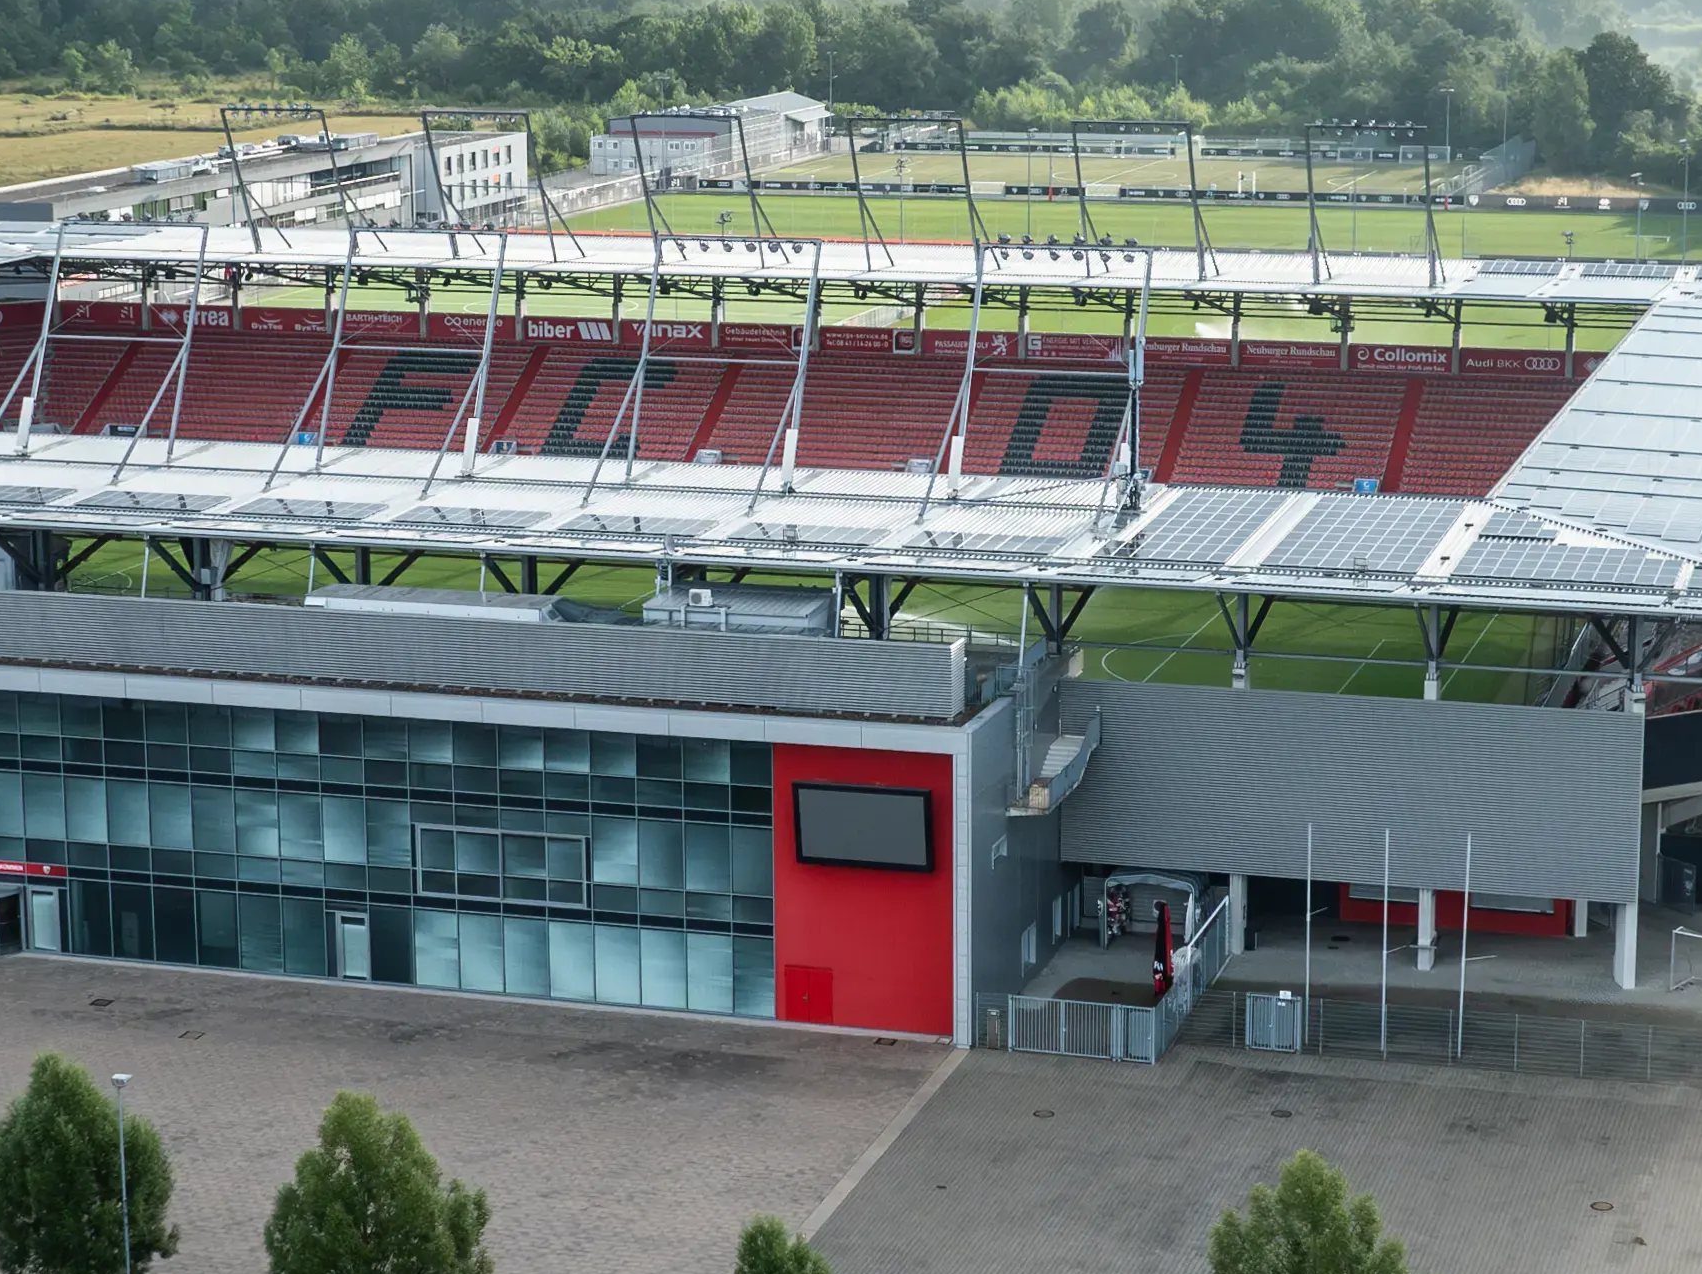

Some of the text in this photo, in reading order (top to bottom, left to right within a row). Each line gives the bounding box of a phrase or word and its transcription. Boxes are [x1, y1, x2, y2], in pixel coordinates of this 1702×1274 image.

[528, 321, 575, 338] biber
[1143, 342, 1227, 354] euburger Rundschau
[1246, 344, 1335, 357] Neuburger Rundschau
[1373, 347, 1447, 363] Collomix
[1465, 357, 1520, 369] Audi BKK
